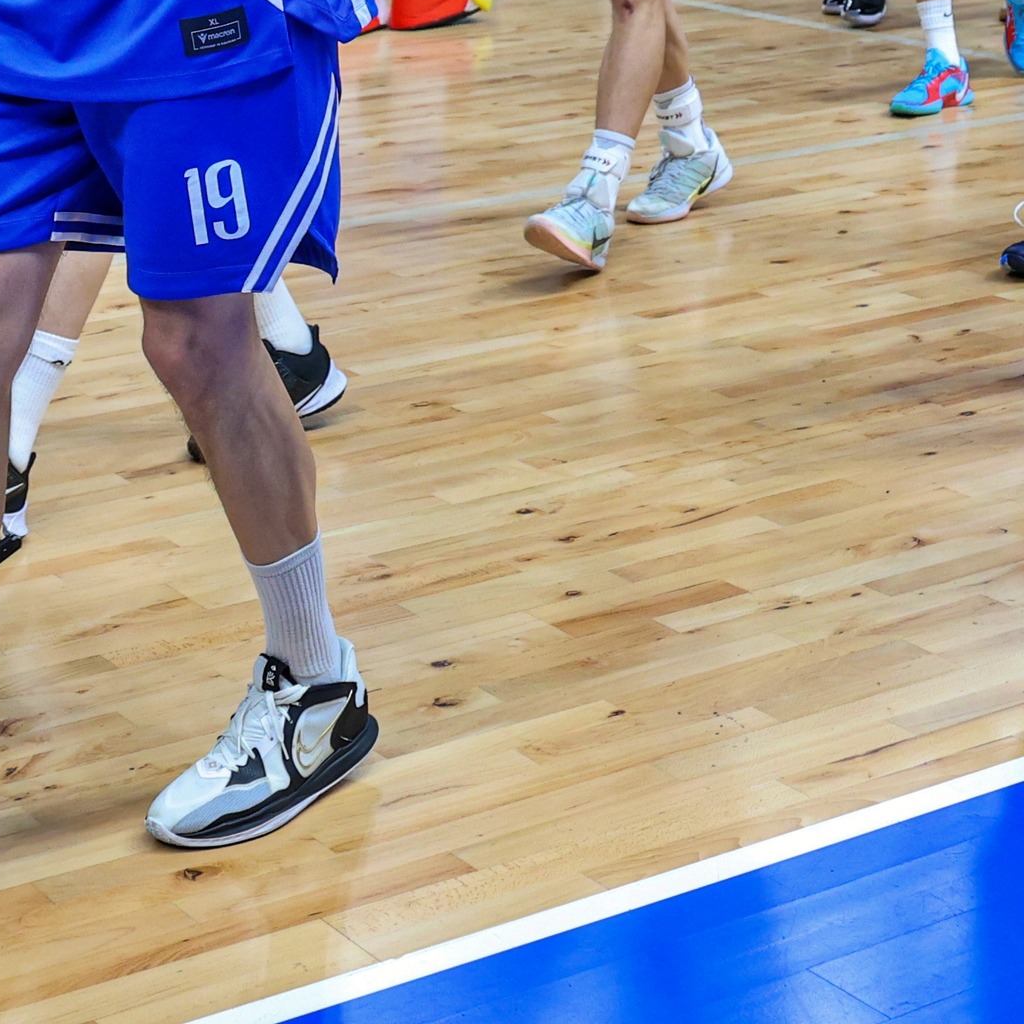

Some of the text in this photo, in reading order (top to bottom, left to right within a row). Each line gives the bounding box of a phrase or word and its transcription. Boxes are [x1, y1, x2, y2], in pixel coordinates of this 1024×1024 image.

[208, 18, 219, 26] XL
[207, 28, 236, 41] macron
[183, 158, 251, 246] 19
